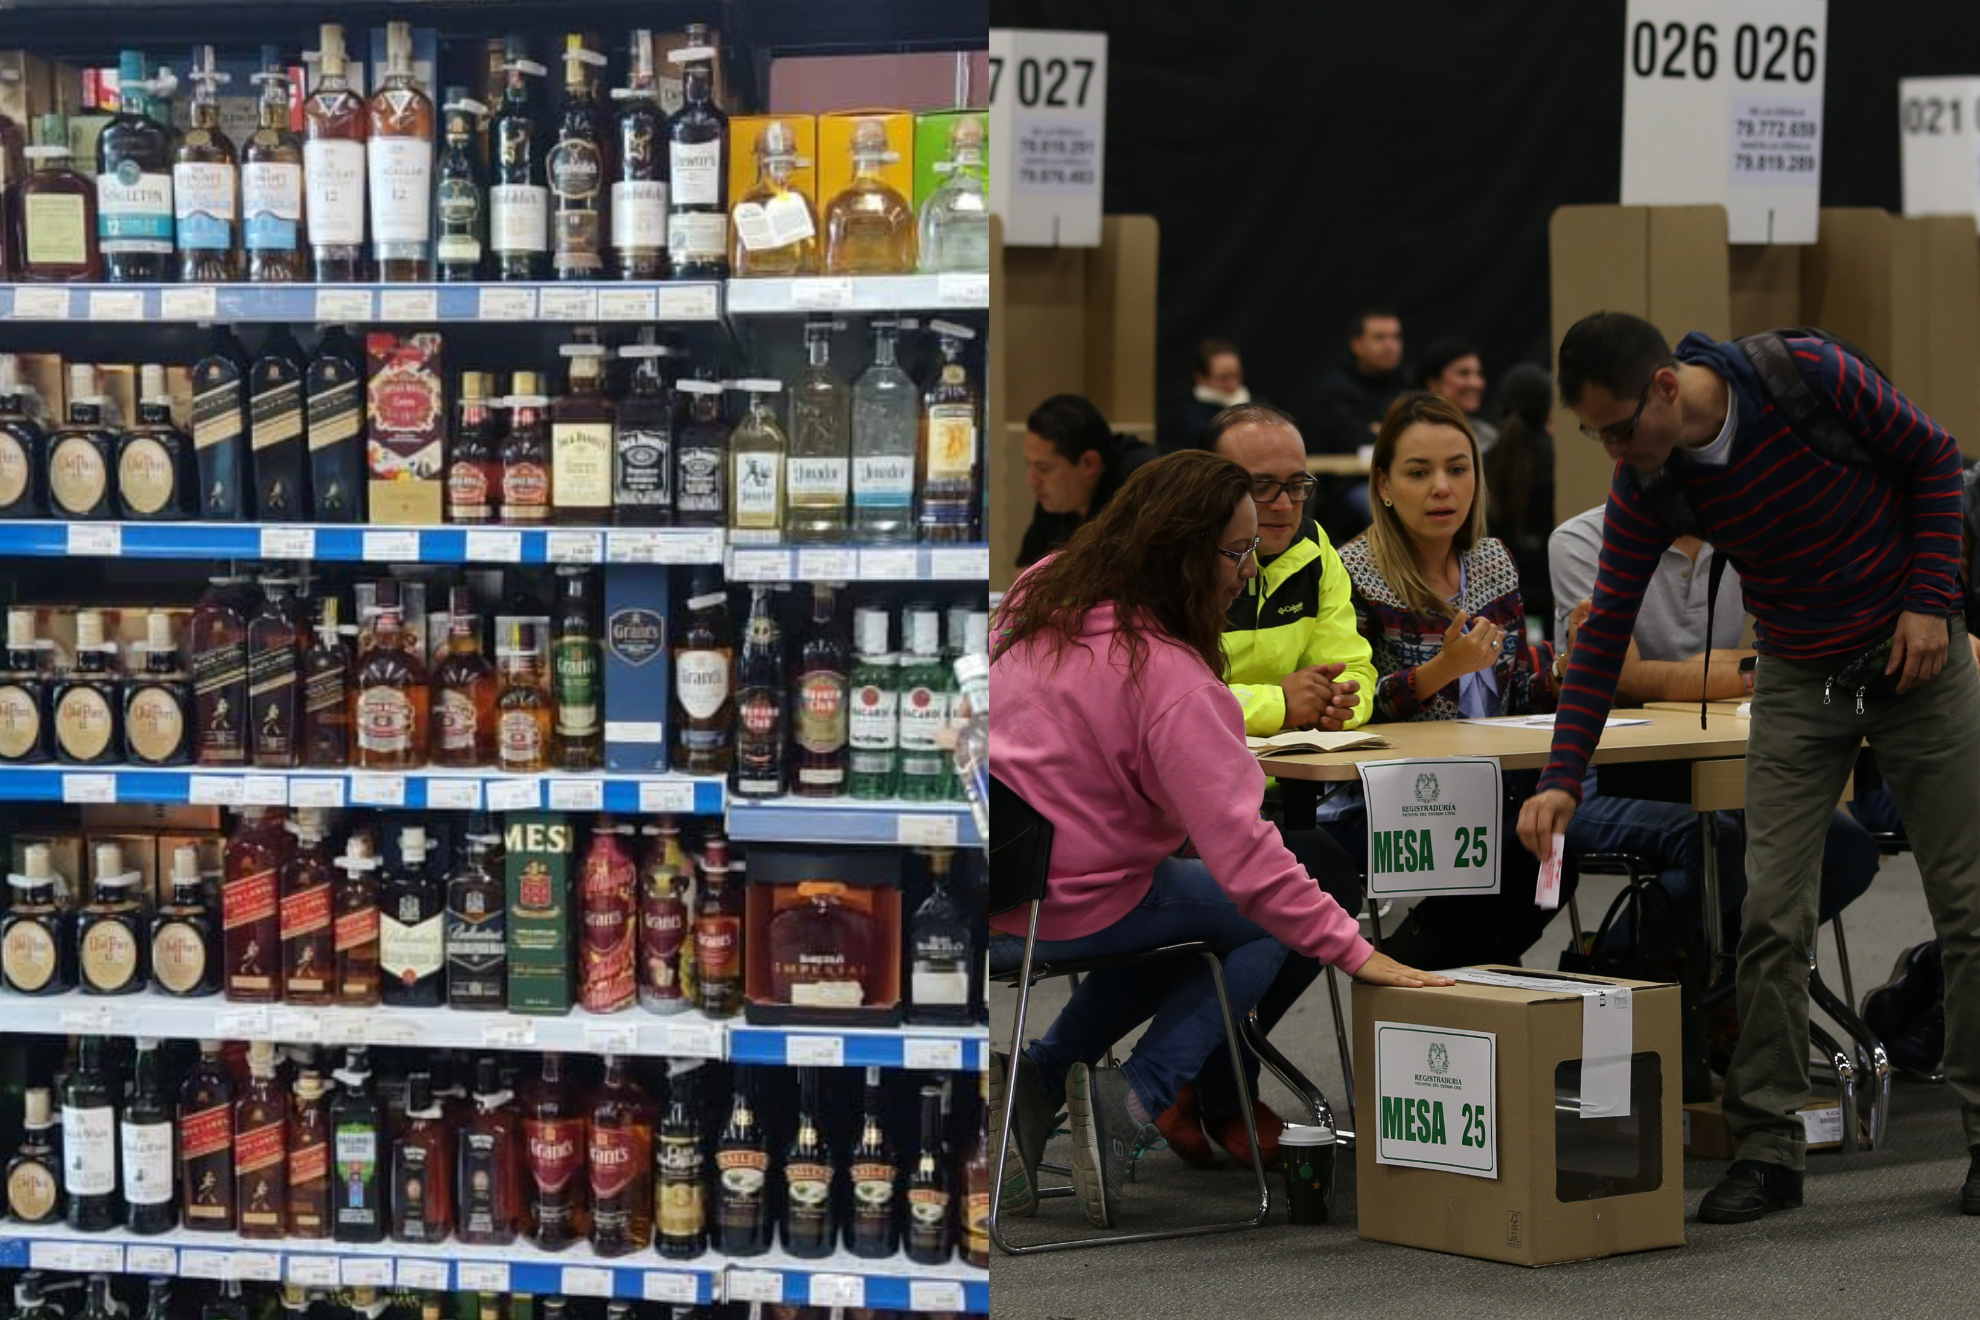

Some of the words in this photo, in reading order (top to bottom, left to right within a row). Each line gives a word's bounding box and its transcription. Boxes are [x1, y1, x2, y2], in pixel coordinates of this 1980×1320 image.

[1633, 20, 1718, 80] 026
[1734, 23, 1817, 83] 026
[1018, 57, 1095, 108] 027
[1401, 803, 1456, 812] REGISTRADURÍA
[1373, 829, 1434, 873] MESA
[1453, 826, 1487, 868] 25
[1414, 1074, 1462, 1085] REGISTRADURÍA
[1382, 1096, 1447, 1145] MESA
[1461, 1103, 1486, 1149] 25
